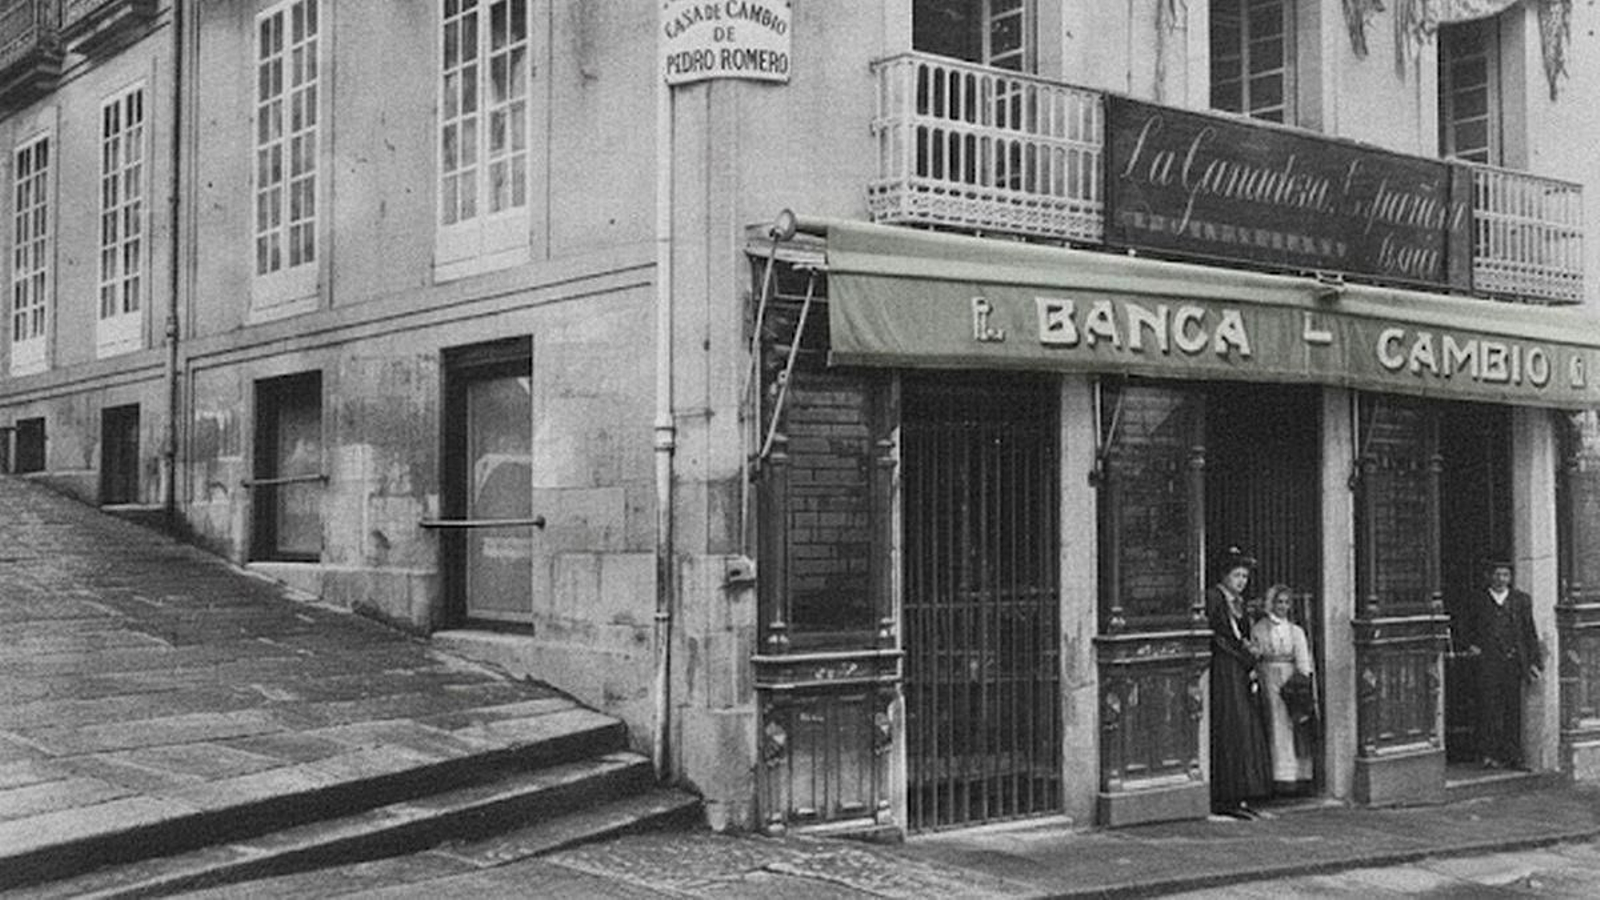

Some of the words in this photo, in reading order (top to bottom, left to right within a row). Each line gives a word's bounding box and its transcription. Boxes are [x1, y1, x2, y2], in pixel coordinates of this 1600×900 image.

[665, 6, 703, 39] CASA
[704, 4, 722, 20] DE
[725, 0, 787, 36] CAMBIO
[713, 26, 736, 42] DE
[720, 48, 788, 74] ROMERO
[1035, 297, 1250, 356] BANCA
[1376, 327, 1550, 388] CAMBIO
